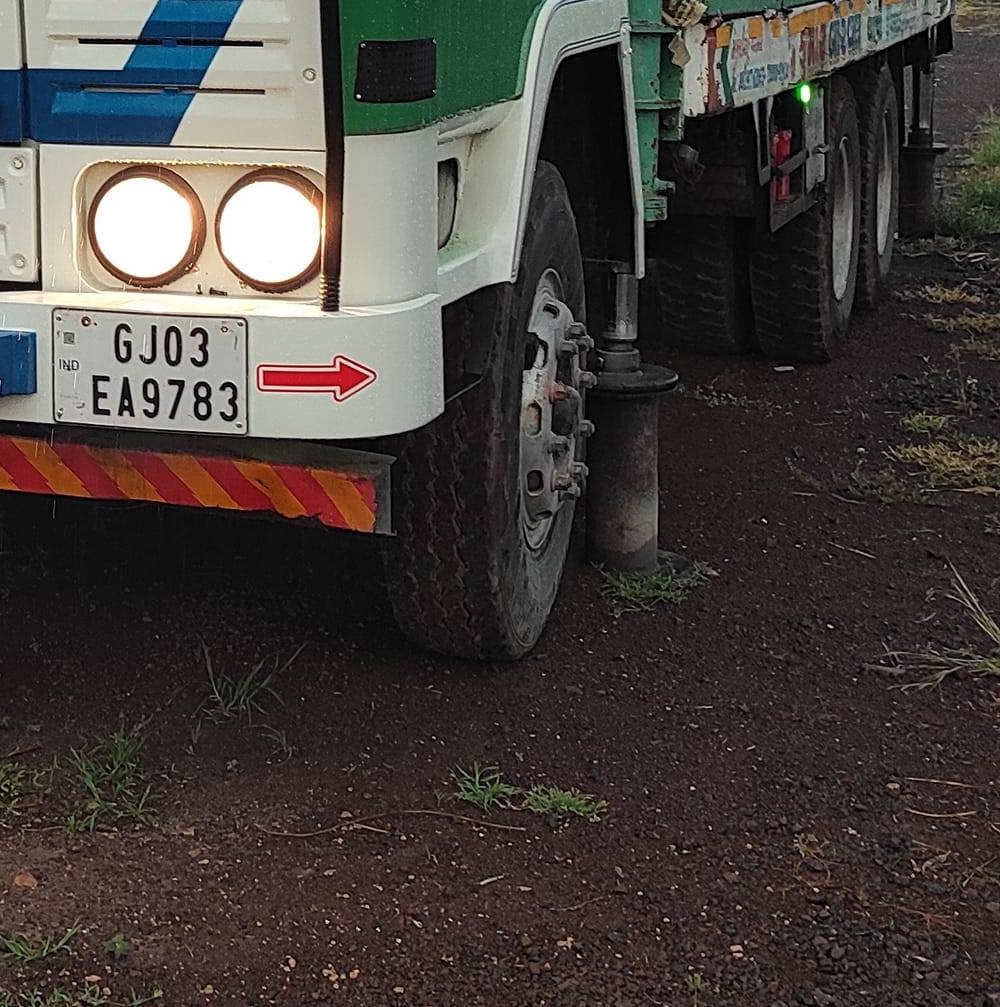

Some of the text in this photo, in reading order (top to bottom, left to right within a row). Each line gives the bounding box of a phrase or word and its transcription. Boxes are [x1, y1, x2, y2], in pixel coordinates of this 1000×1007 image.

[59, 358, 80, 371] IND
[113, 323, 209, 367] GJ03
[92, 374, 239, 422] EA9783
